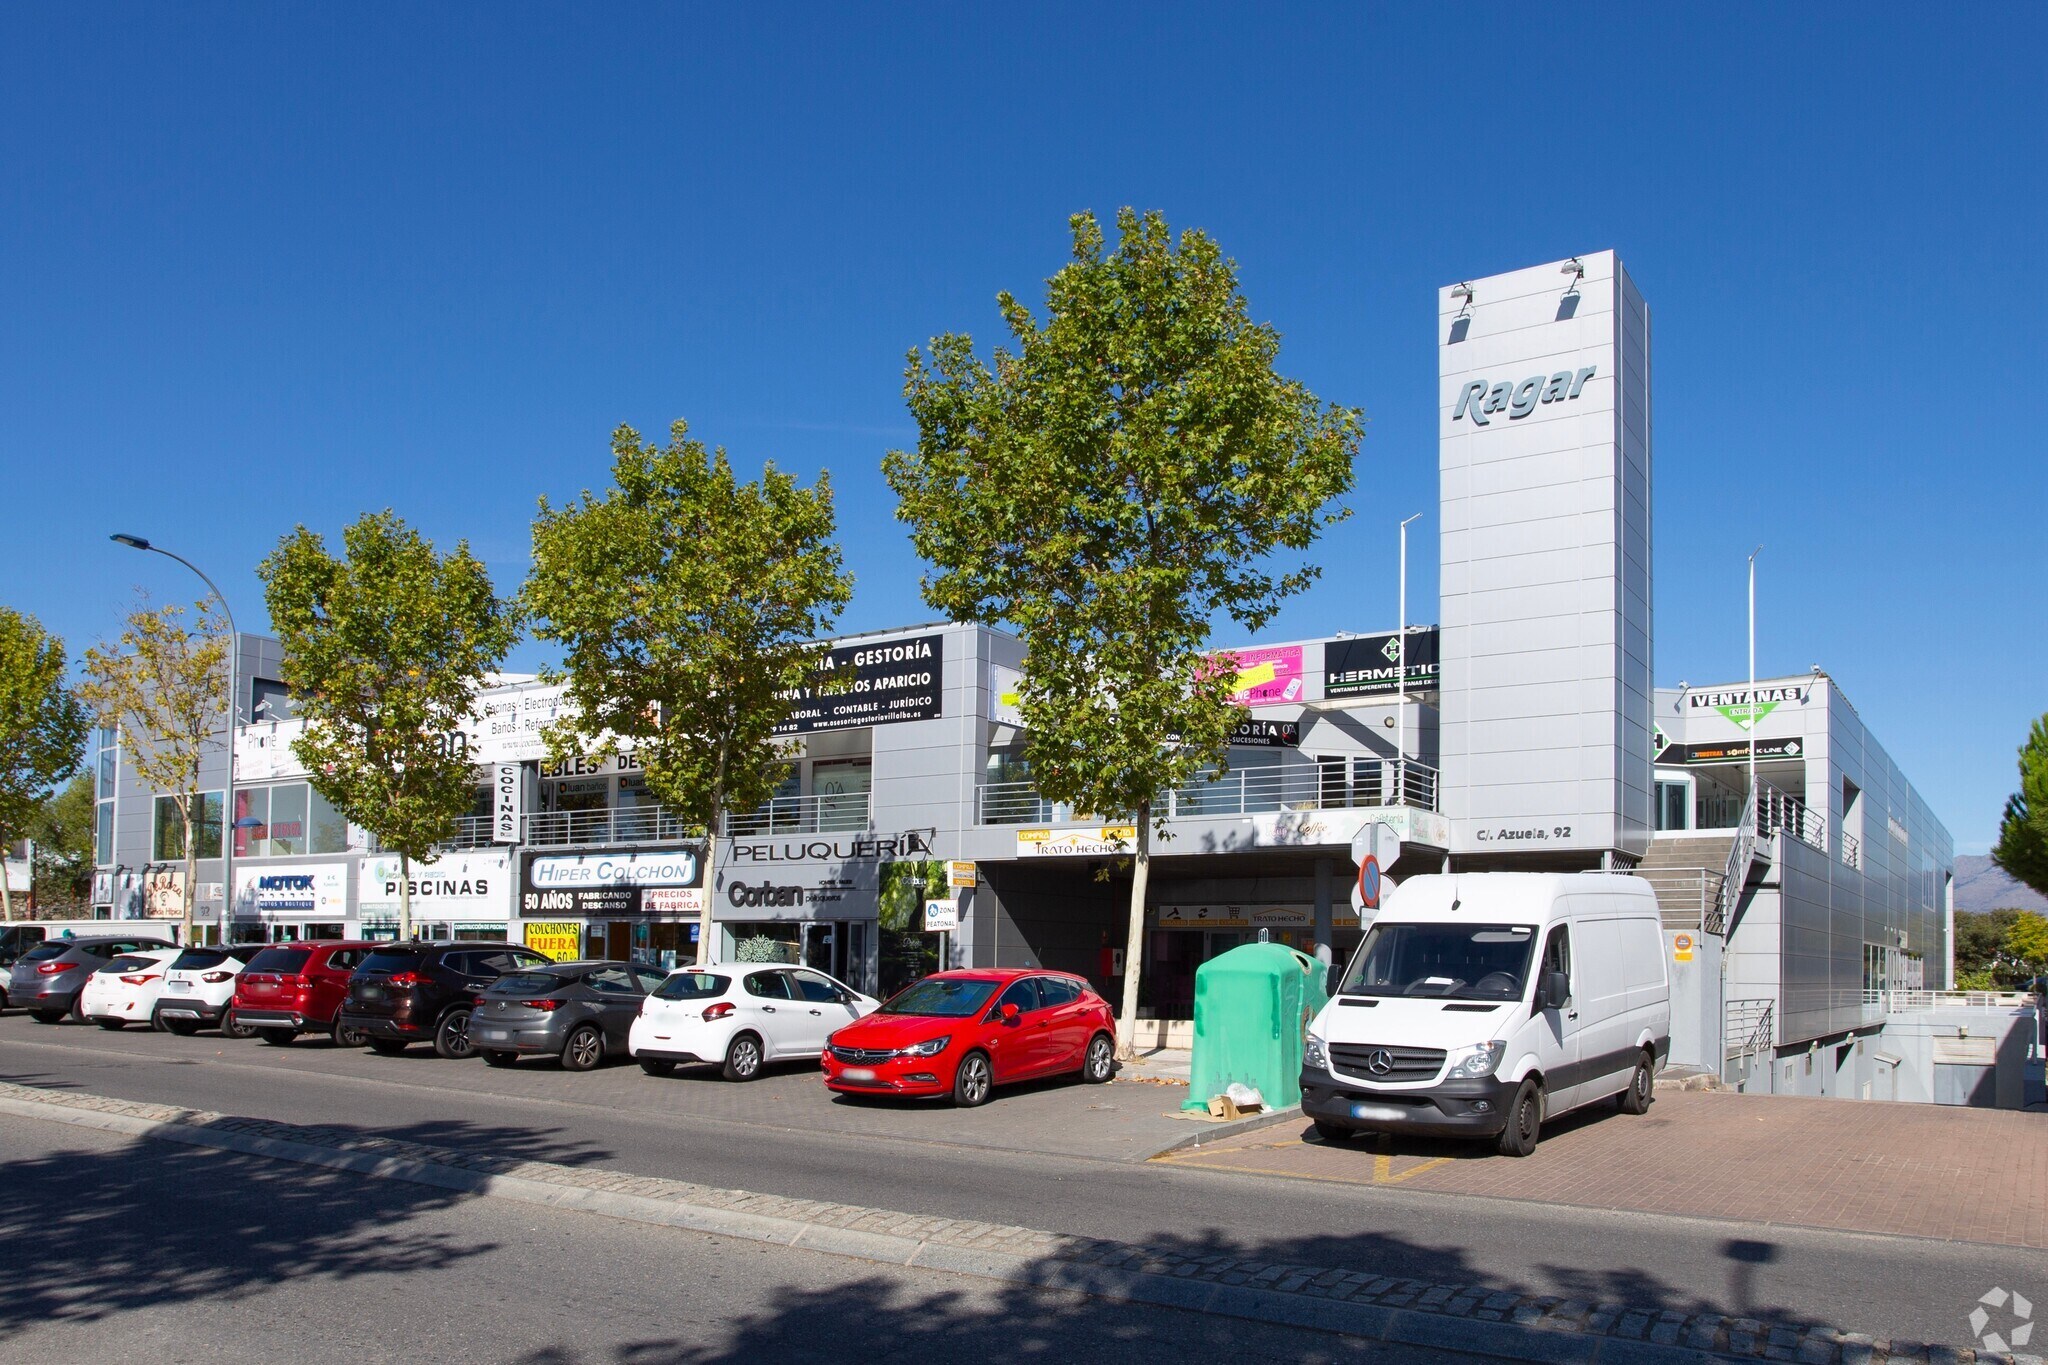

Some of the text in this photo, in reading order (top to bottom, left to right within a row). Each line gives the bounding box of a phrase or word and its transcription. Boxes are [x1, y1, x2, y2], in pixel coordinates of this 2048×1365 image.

[1452, 365, 1597, 427] Ragar
[854, 640, 932, 667] GESTORÍA
[874, 672, 931, 691] APARICIO
[1330, 686, 1359, 694] VENTANAS
[1359, 683, 1393, 691] DIFERENTES,
[1695, 688, 1797, 707] VENTANAS
[833, 702, 878, 715] CONTABLE
[888, 696, 932, 710] JURÍDICO
[491, 720, 517, 735] Baños
[779, 724, 788, 732] 14
[813, 711, 922, 728] www.asesoriagestoriavillalba.es
[618, 754, 638, 770] DE
[567, 782, 608, 792] luan baños
[500, 767, 514, 831] COCINAS
[1020, 831, 1050, 841] COMPRA
[1553, 826, 1572, 838] 92
[733, 834, 933, 862] PELUQUERÍA
[1035, 842, 1117, 855] TRATO HECHO
[538, 861, 687, 882] HIPER COLCHON
[386, 879, 488, 896] PISCINAS
[651, 890, 693, 899] PRECIOS
[728, 880, 804, 908] Corban
[525, 889, 574, 910] 50 AÑOS
[578, 891, 632, 900] FABRICANDO
[582, 901, 627, 910] DESCANSO
[644, 901, 700, 910] DE FABRICA
[926, 920, 955, 928] PEATONAL
[1253, 915, 1277, 923] TRATO
[529, 923, 578, 935] COLCHONES
[529, 937, 577, 950] FUERA
